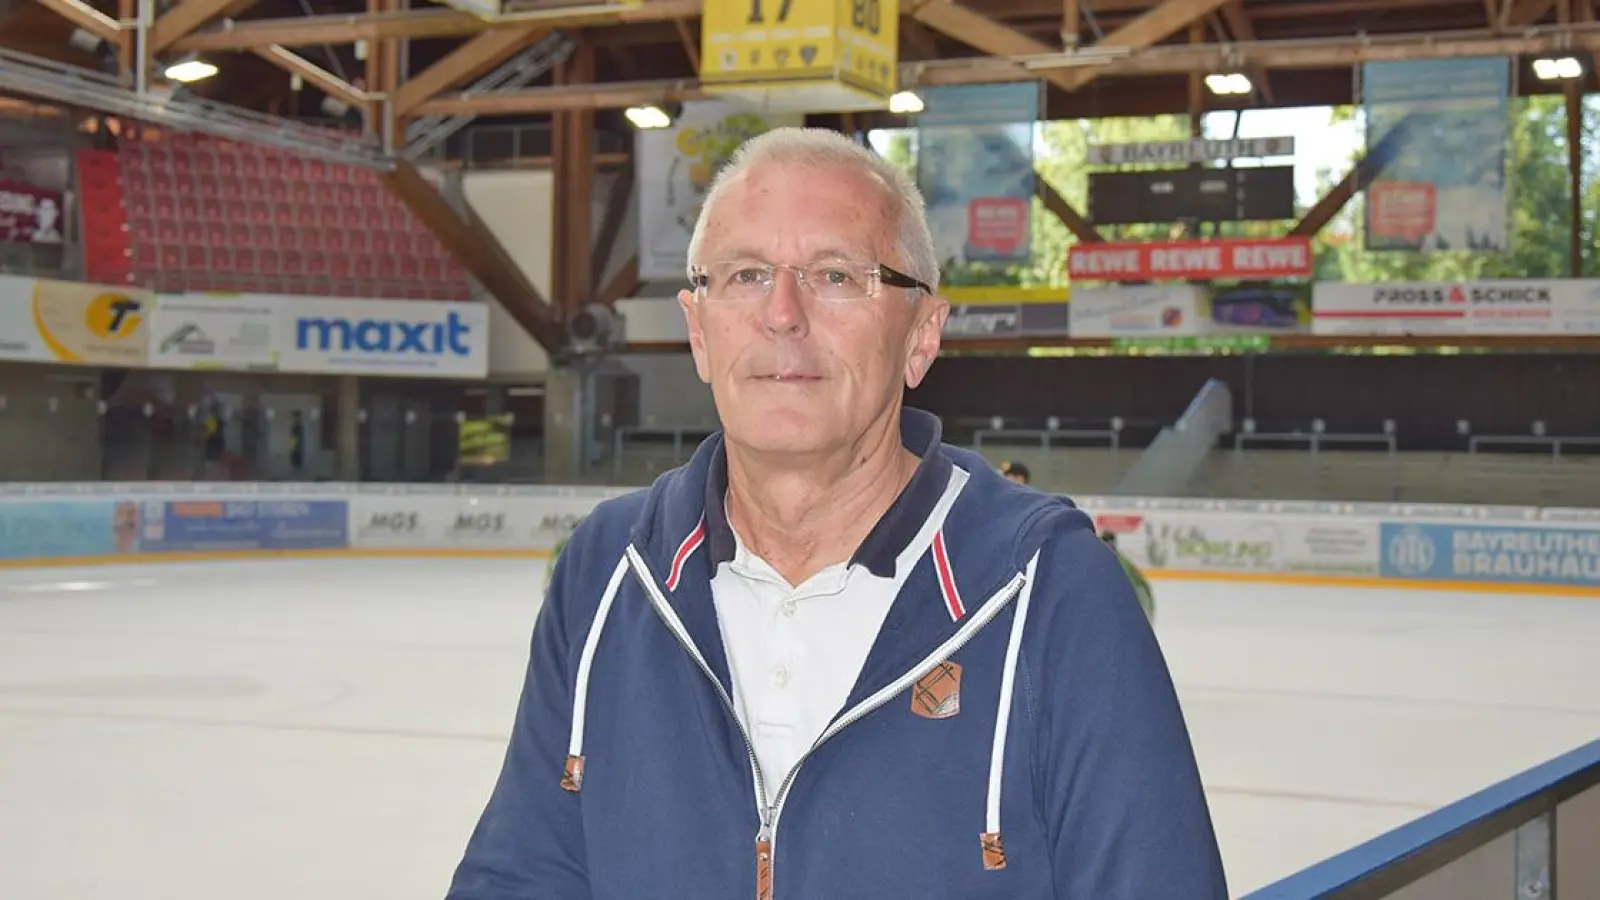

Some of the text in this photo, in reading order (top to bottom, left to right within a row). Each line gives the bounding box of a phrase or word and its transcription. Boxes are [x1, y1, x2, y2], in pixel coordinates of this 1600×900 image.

[1120, 140, 1257, 161] BAYREUTH
[1071, 244, 1307, 273] REWE REWE REWE
[1470, 287, 1552, 304] SCHICK
[296, 311, 470, 356] maxit
